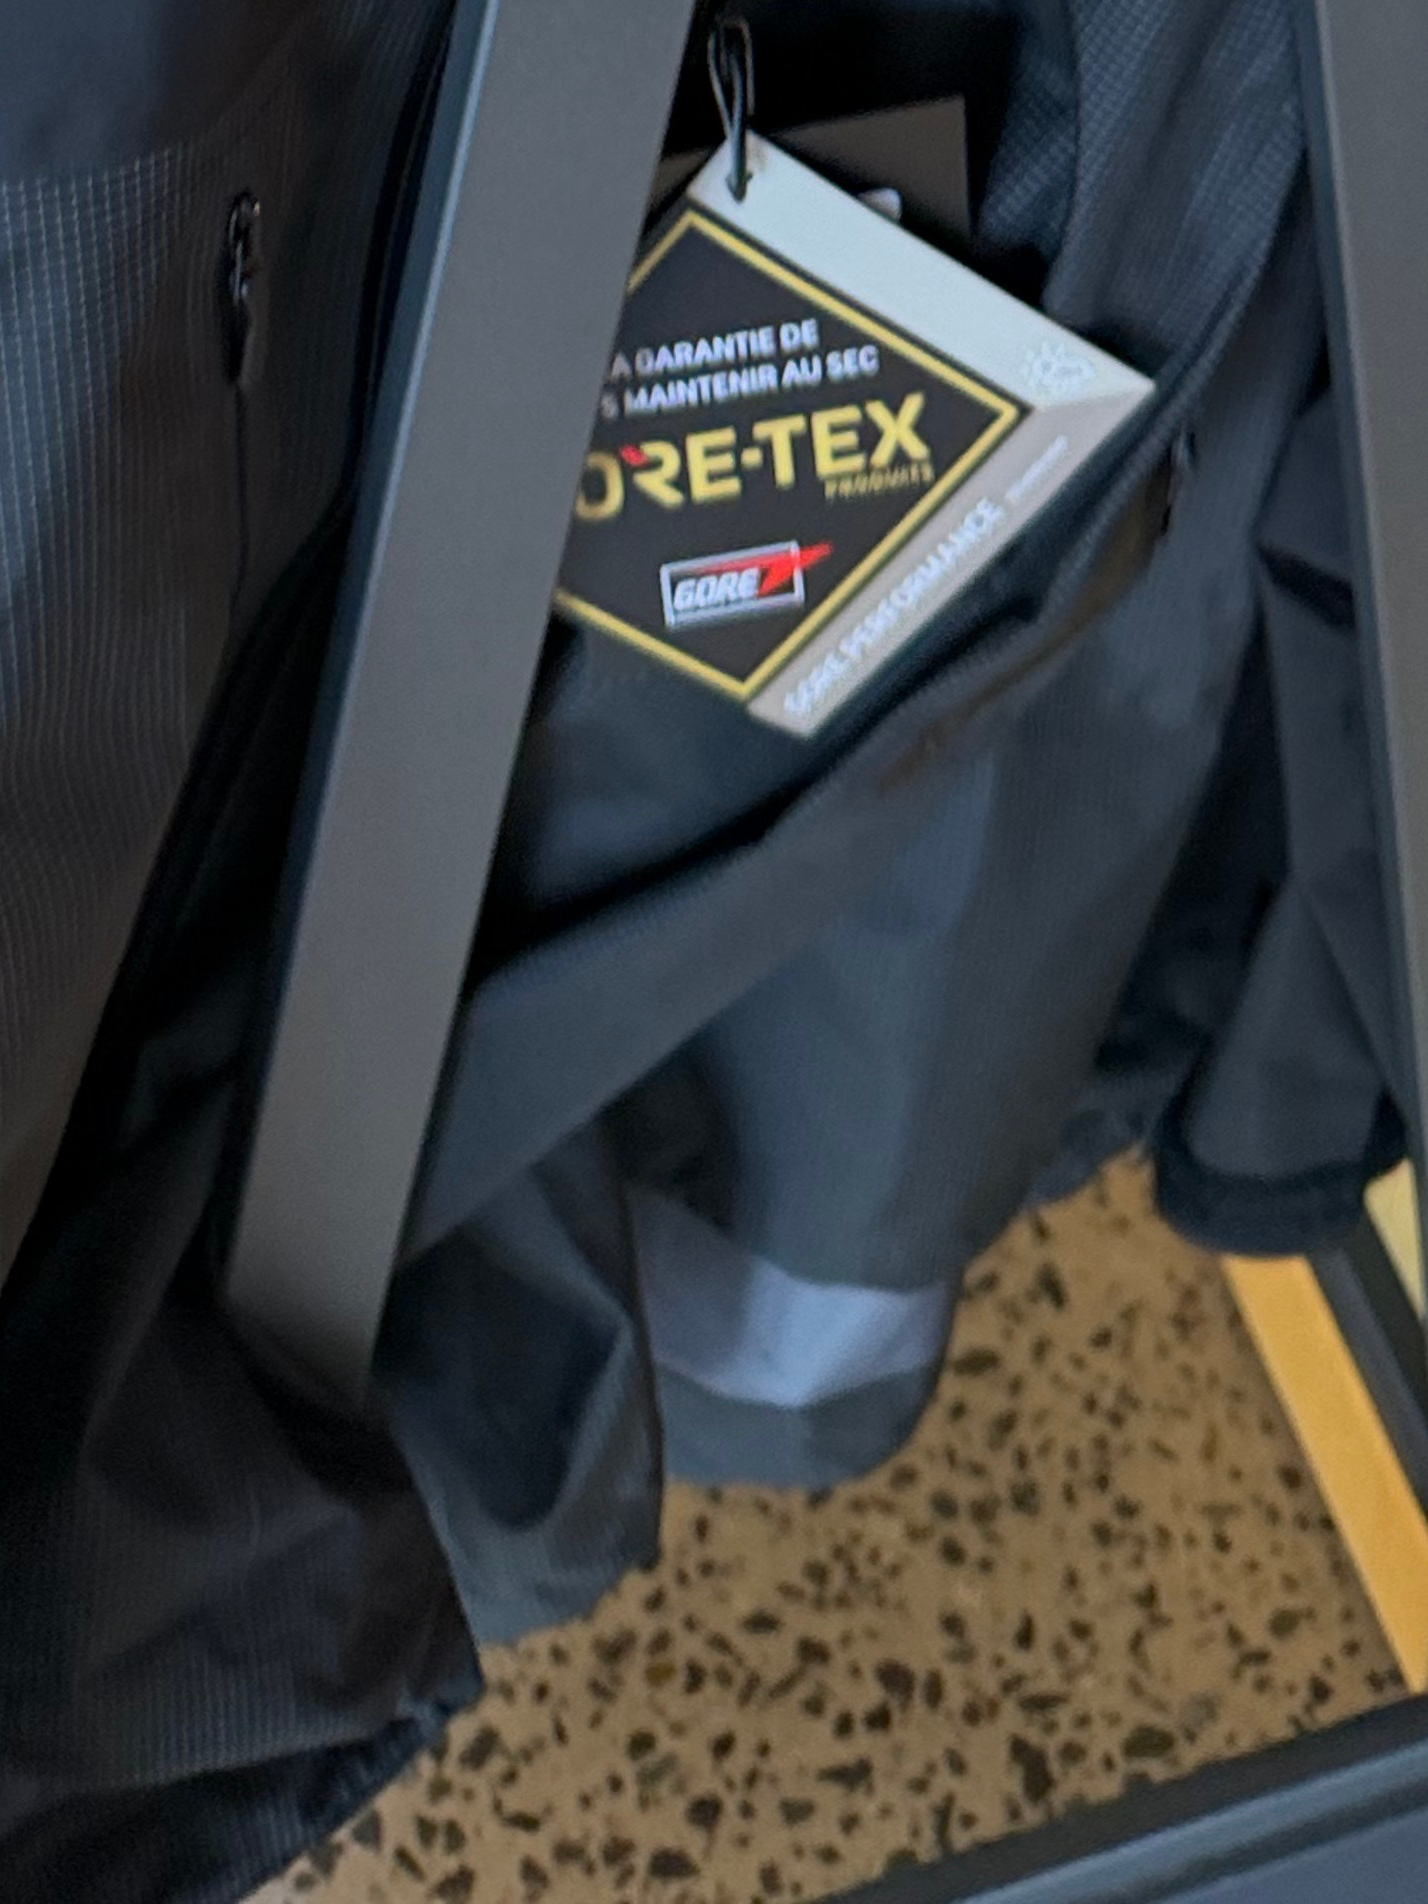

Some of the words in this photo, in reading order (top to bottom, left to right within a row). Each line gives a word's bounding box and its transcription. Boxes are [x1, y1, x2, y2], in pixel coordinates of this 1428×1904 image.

[635, 325, 777, 376] GARANTIE
[780, 318, 819, 351] DE
[624, 363, 779, 418] MAINTENIR
[782, 354, 822, 387] AU
[826, 344, 880, 379] SEC
[574, 393, 930, 522] ORE-TEX
[674, 566, 761, 611] GORE
